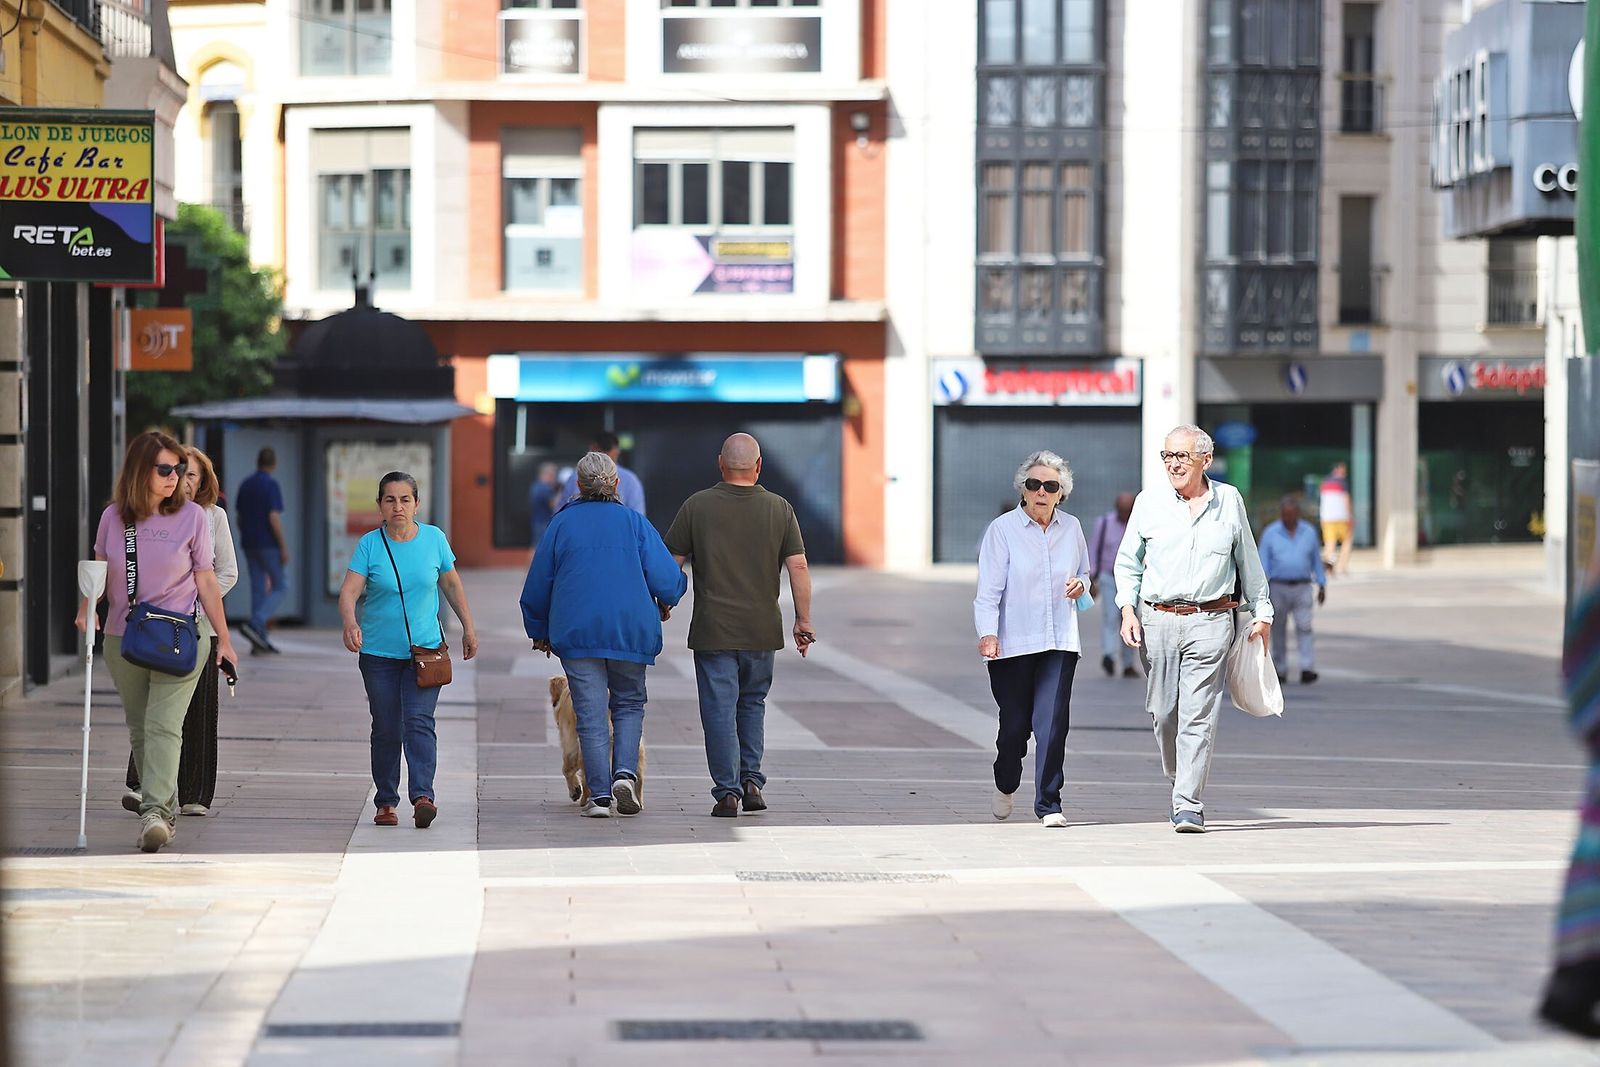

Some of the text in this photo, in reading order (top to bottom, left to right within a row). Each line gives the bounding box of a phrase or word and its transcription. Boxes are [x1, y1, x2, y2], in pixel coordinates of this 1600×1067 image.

[1, 125, 151, 143] LON DE JUEGOS
[4, 145, 124, 174] Café Bar
[0, 176, 149, 201] LUS ULTRA
[13, 225, 95, 253] RETA
[71, 244, 112, 257] bet.es
